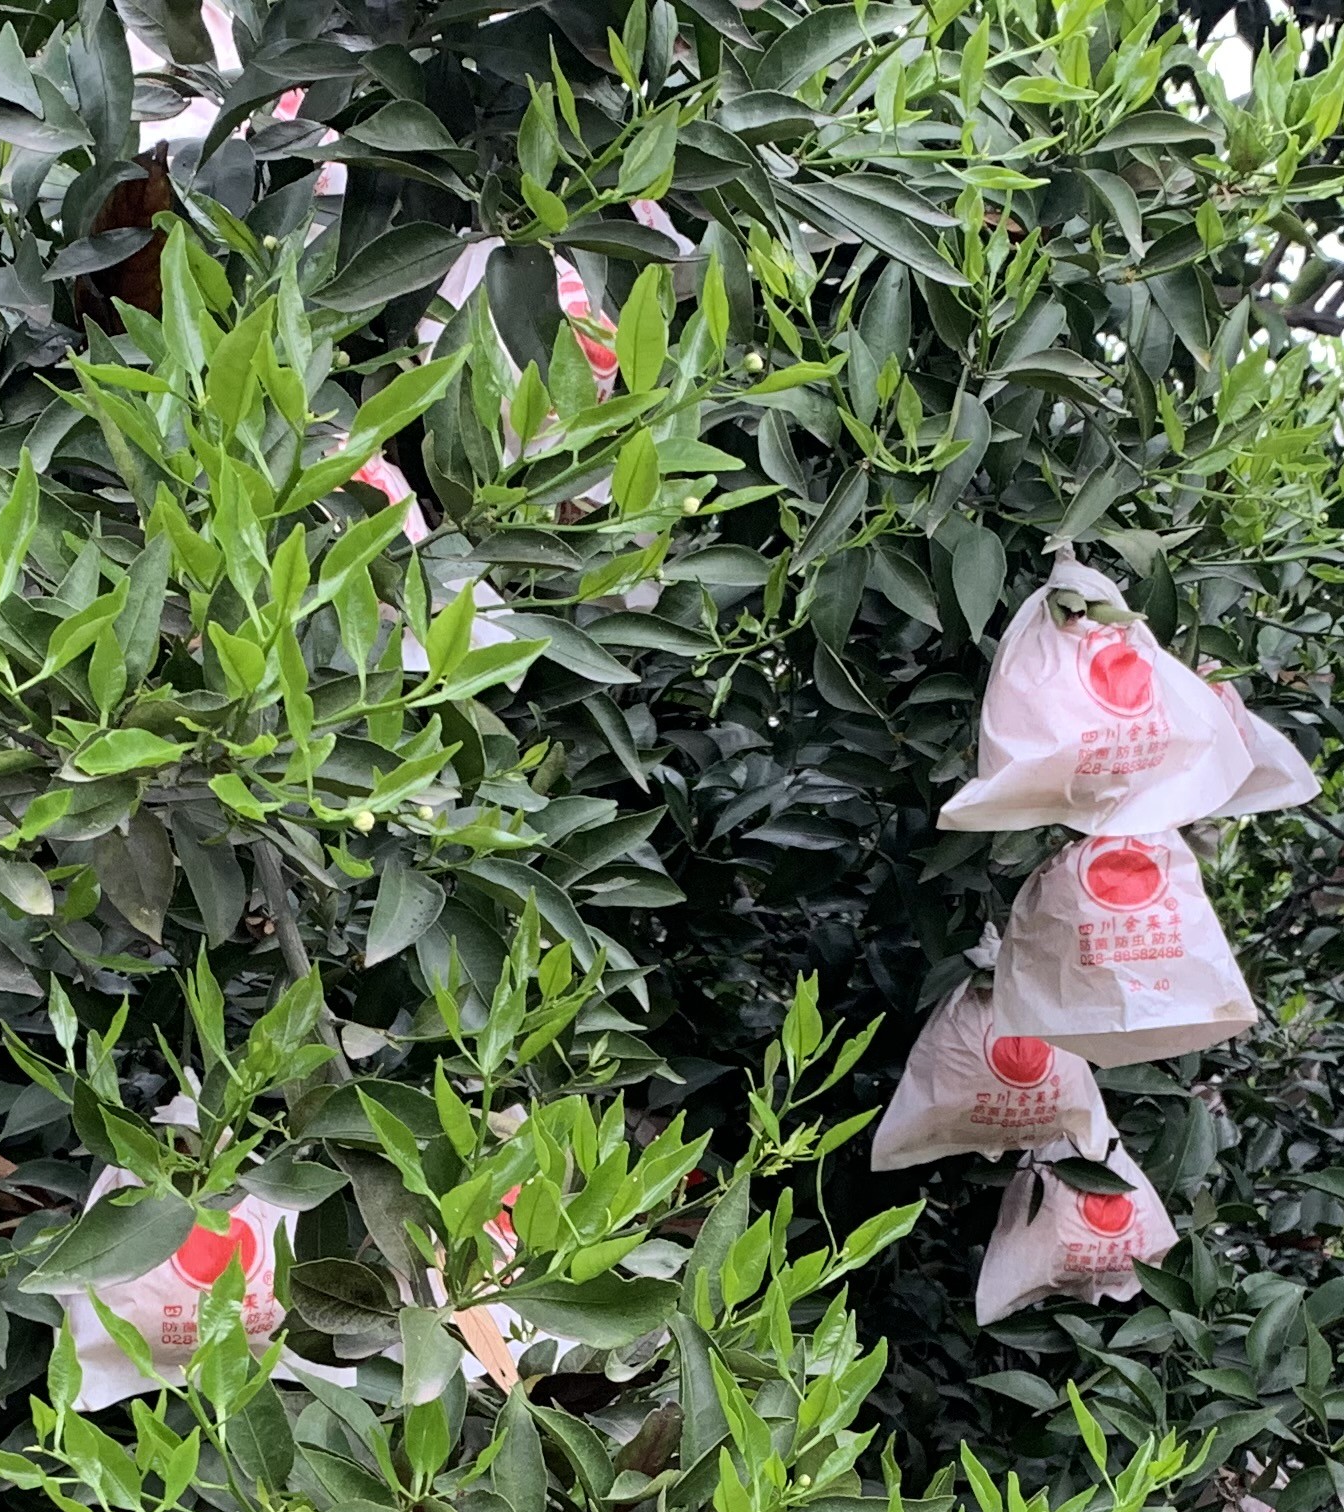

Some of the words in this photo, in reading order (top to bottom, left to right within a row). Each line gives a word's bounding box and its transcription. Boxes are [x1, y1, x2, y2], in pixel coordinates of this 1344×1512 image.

[1078, 914, 1182, 936] 四川金果丰
[1080, 945, 1184, 966] 028-88582486
